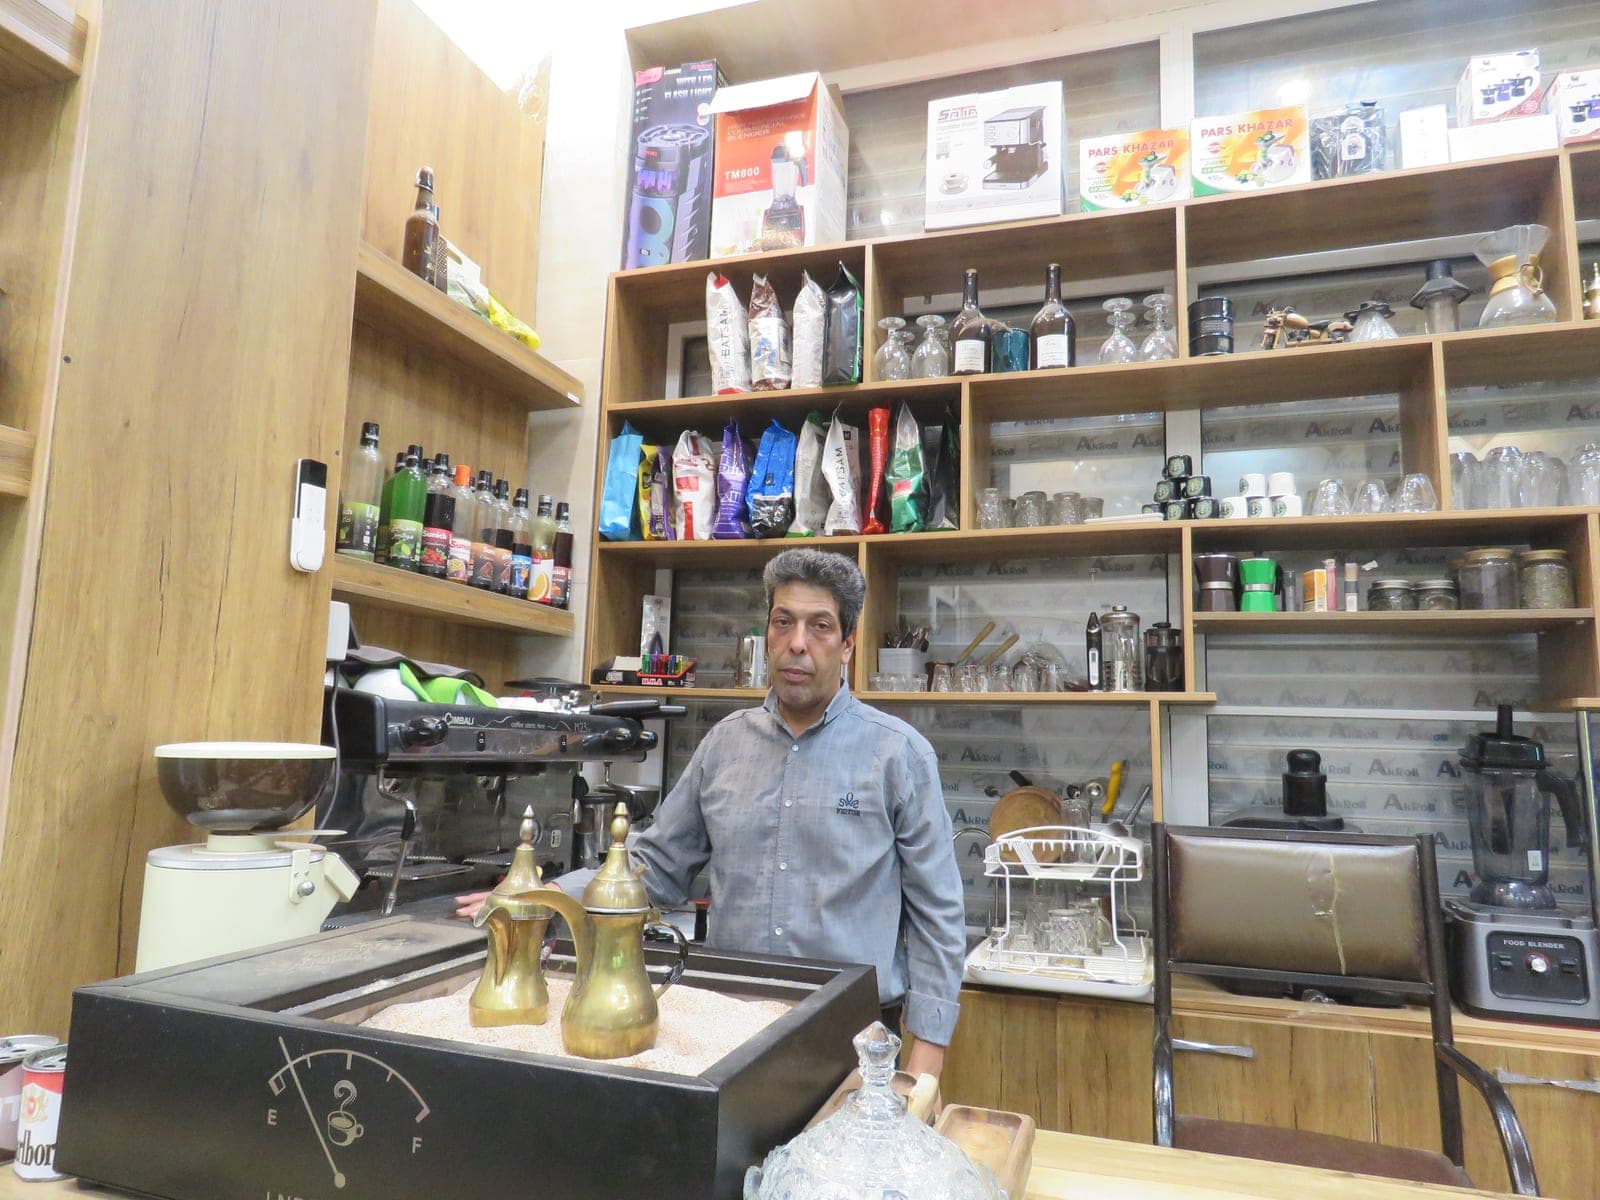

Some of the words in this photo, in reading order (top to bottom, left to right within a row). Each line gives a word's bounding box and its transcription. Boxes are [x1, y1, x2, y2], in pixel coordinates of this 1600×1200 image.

[1200, 126, 1233, 138] PARS
[1238, 118, 1293, 134] KHAZAR
[1088, 146, 1118, 158] PARS
[1123, 139, 1175, 154] KHAZAR
[961, 746, 1002, 763] AkRoll
[1367, 757, 1420, 777] AkRoll
[1383, 792, 1436, 812] AkRoll
[1503, 939, 1526, 948] FOOD
[1527, 941, 1566, 950] BLENDER
[267, 1108, 278, 1126] E
[412, 1136, 423, 1154] F
